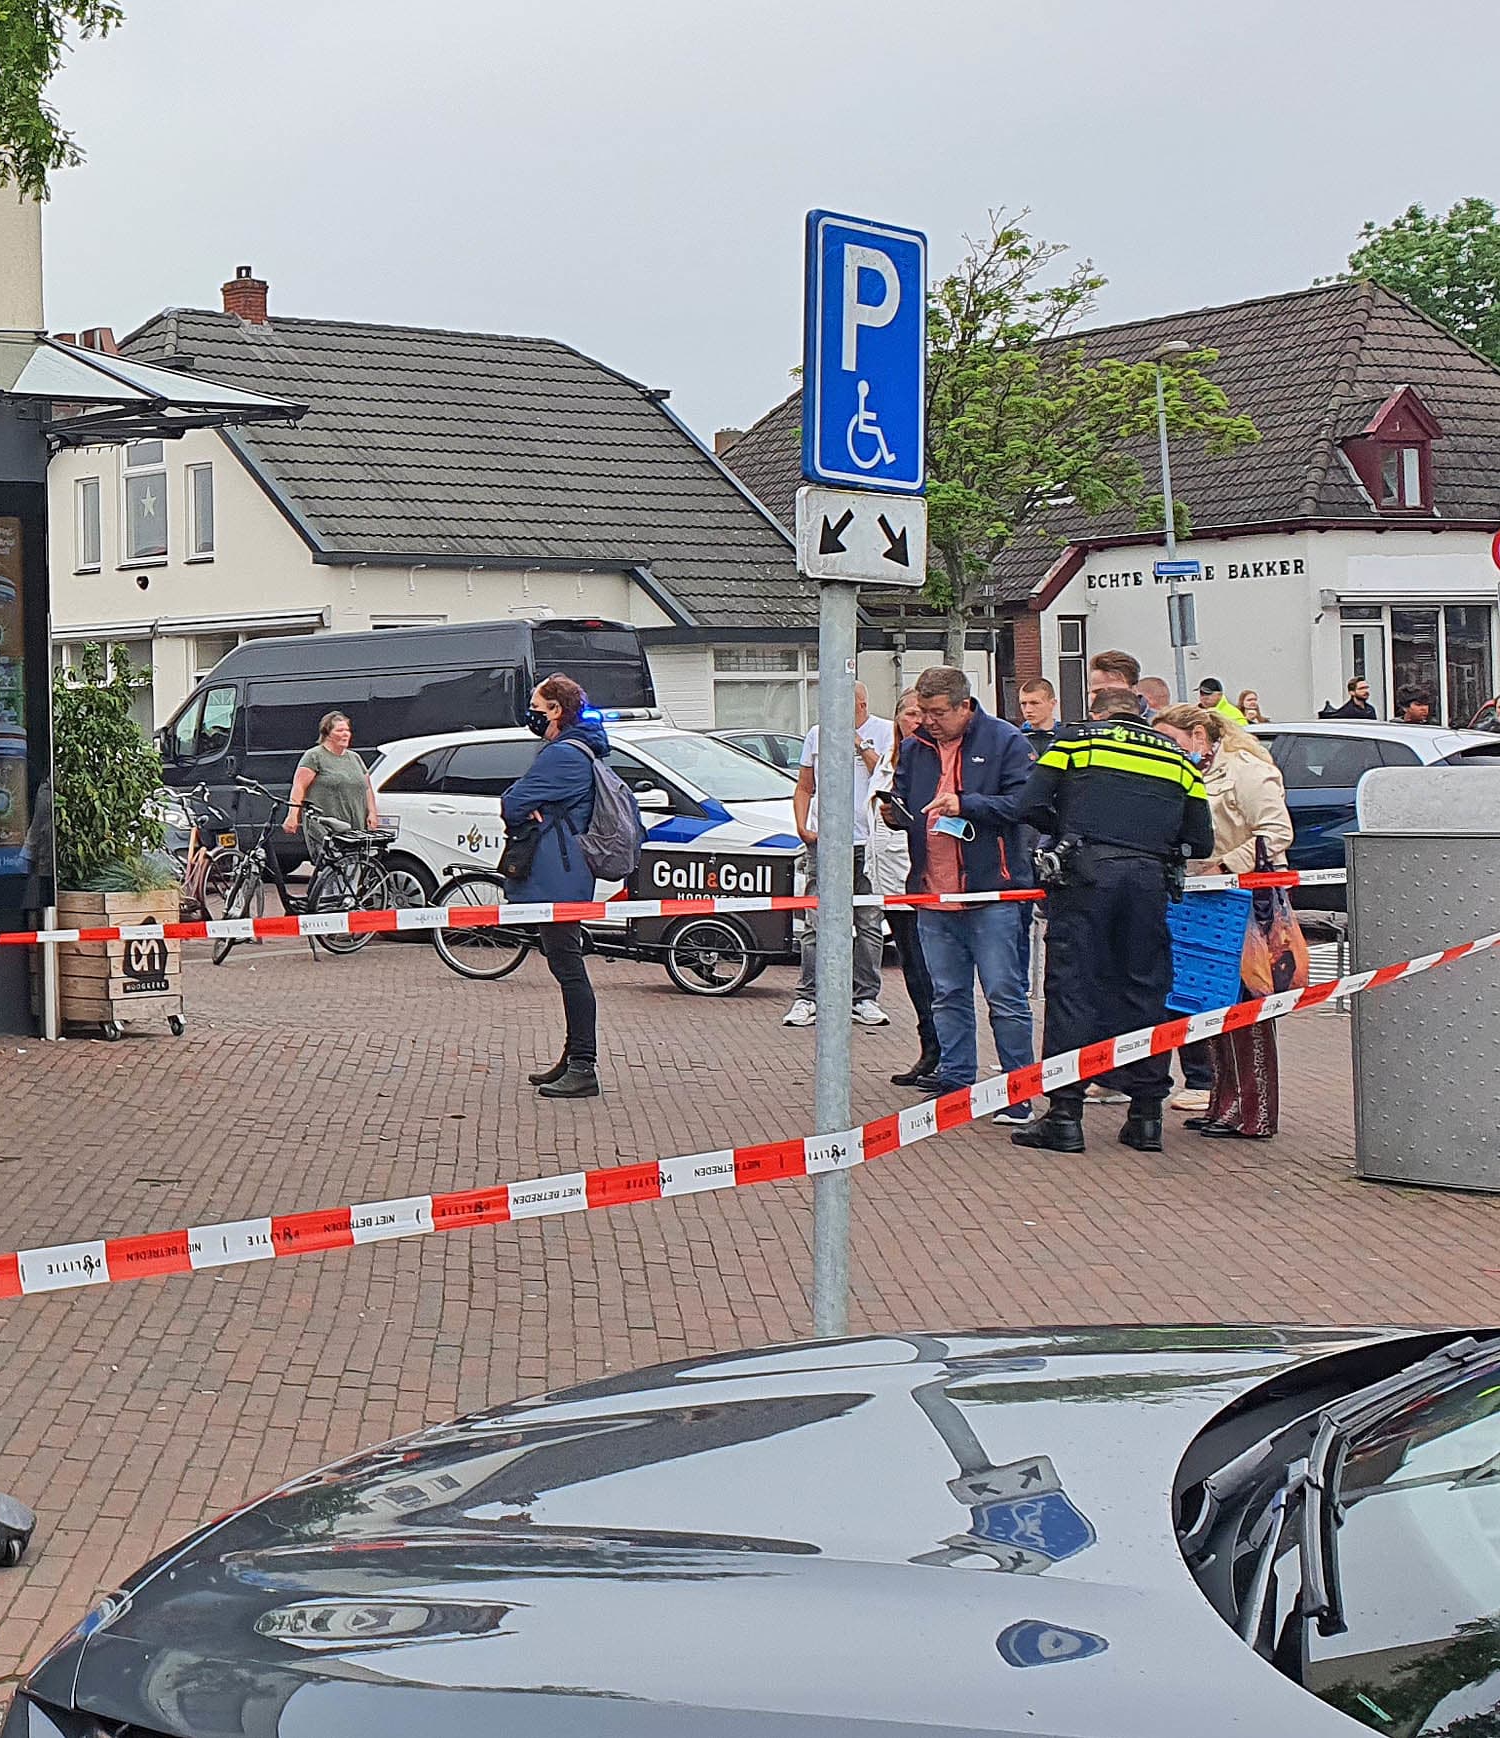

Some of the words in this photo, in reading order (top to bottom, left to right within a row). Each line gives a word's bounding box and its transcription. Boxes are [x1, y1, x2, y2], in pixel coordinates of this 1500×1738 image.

[841, 243, 901, 373] P
[1087, 571, 1143, 589] ECHTE
[1228, 559, 1305, 580] BAKKER
[512, 1189, 560, 1205] BETREDEN
[562, 1186, 582, 1198] NIET
[323, 1217, 373, 1233] BETREDEN
[375, 1214, 396, 1225] NIET
[126, 1248, 178, 1263] BETREDEN
[180, 1242, 202, 1255] NIET
[47, 1255, 101, 1276] POLITIE
